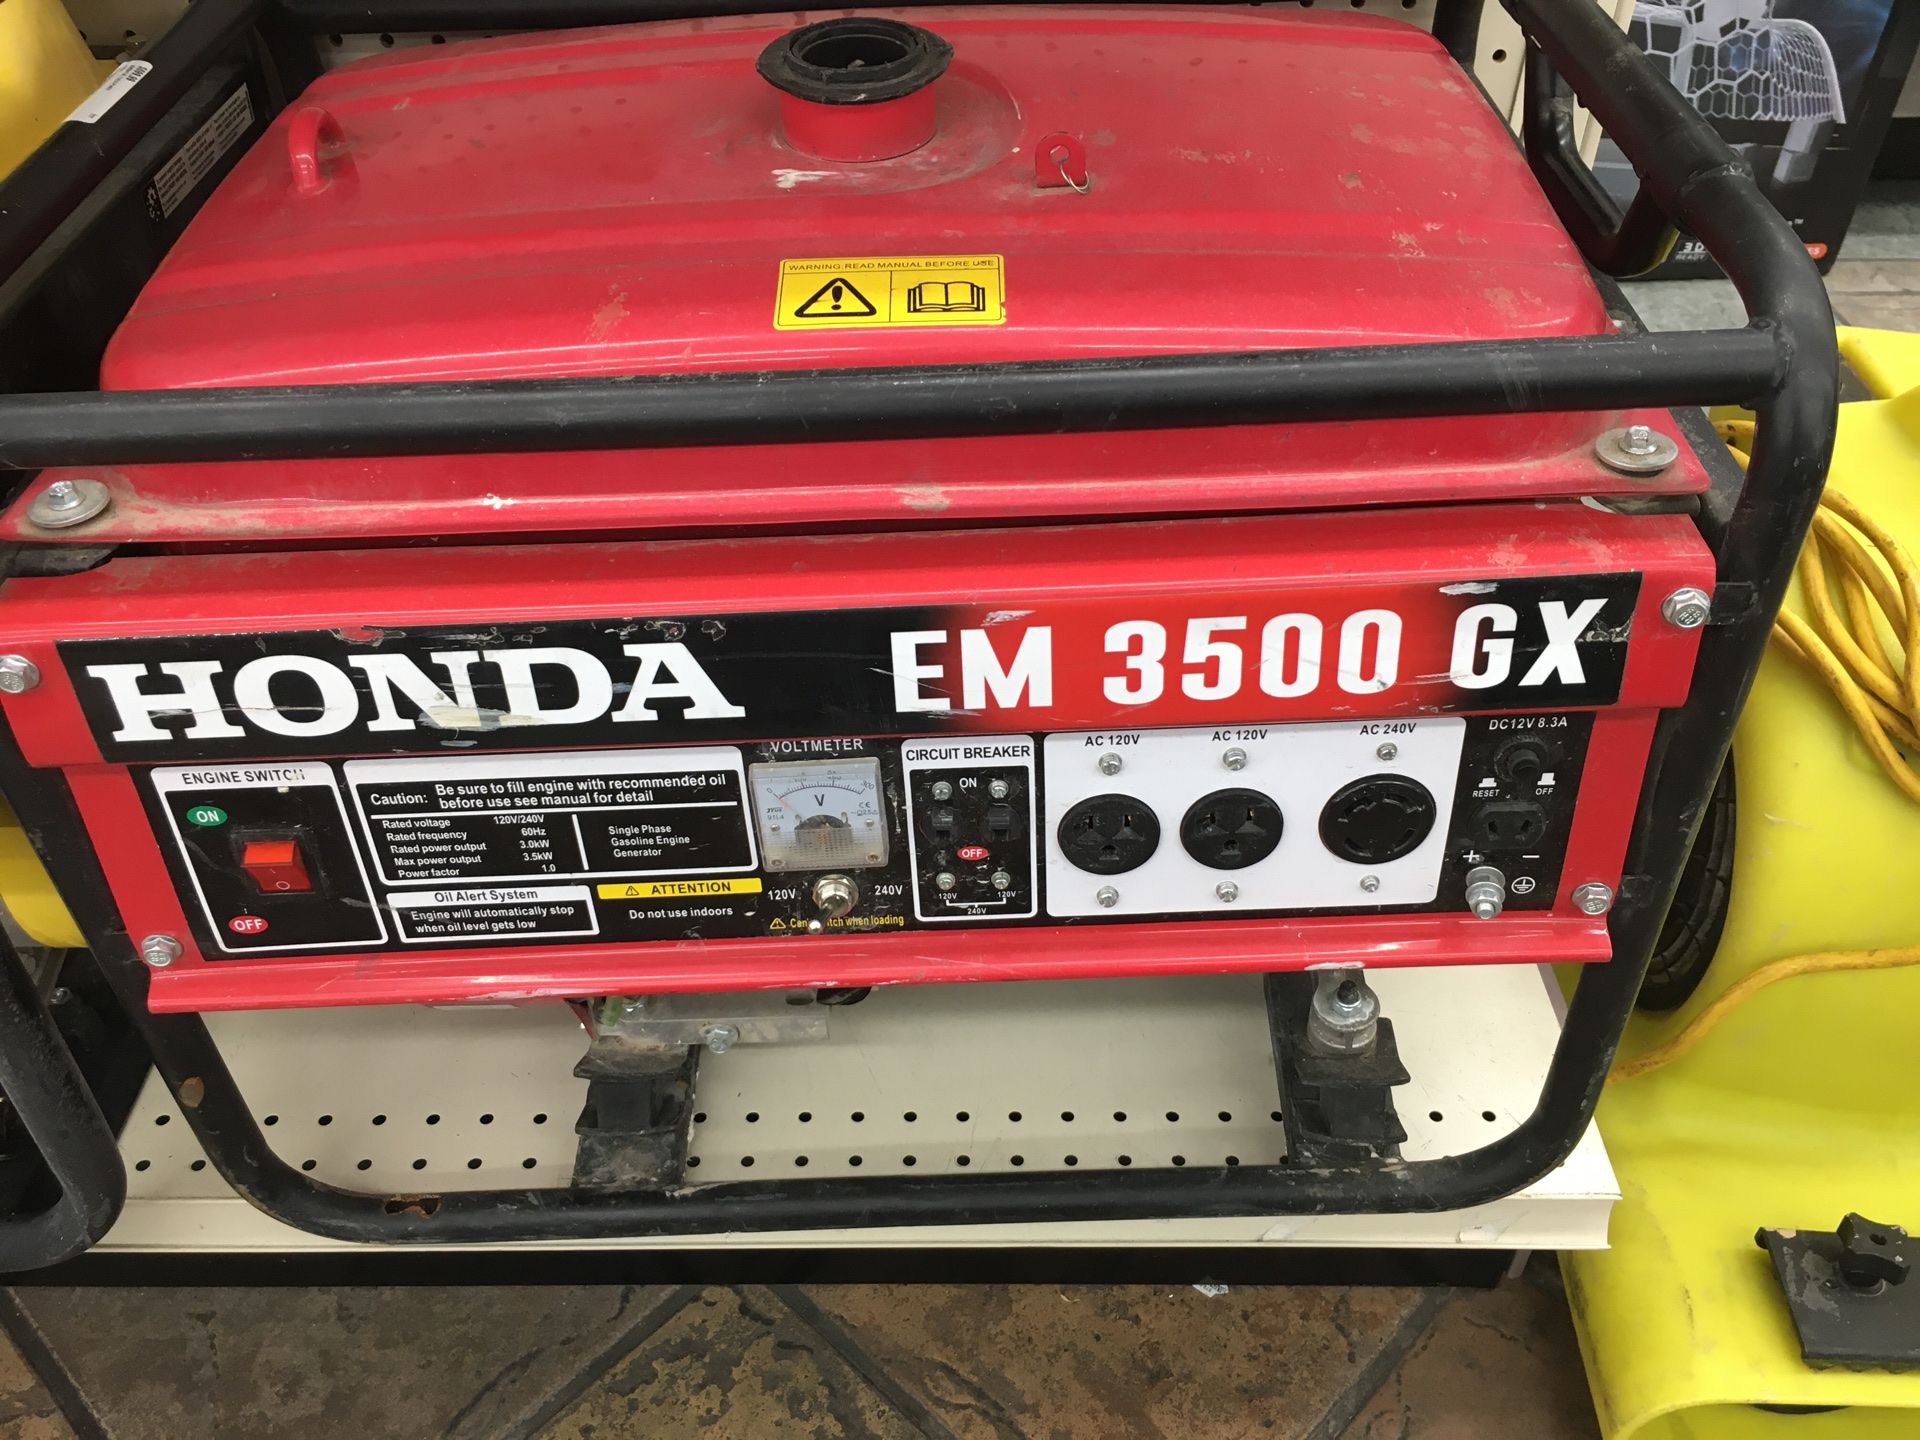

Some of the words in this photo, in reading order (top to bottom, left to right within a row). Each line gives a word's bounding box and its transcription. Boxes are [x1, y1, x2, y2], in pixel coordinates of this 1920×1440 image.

[877, 261, 922, 269] MANUAL
[925, 260, 970, 268] BEFORE
[890, 626, 1053, 713] EM
[1103, 609, 1402, 704] 3500
[1449, 598, 1609, 691] GX
[86, 642, 746, 742] HONDA
[1538, 716, 1567, 728] 8.3A
[1212, 730, 1231, 742] AC
[1236, 729, 1268, 741] 120V
[1360, 724, 1380, 736] AC
[1382, 723, 1417, 735] 240V
[770, 739, 863, 752] VOLTMETER
[1085, 736, 1104, 746] AC
[1108, 734, 1140, 746] 120V
[906, 747, 960, 761] CIRCUIT
[963, 745, 1030, 759] BREAKER
[181, 771, 242, 785] ENGINE
[435, 784, 454, 796] Be
[457, 785, 488, 795] sure
[490, 782, 505, 794] to
[507, 781, 525, 793] fill
[527, 780, 574, 795] engine
[577, 778, 606, 791] with
[608, 775, 706, 790] recommended
[709, 773, 726, 786] oil
[959, 778, 977, 788] ON
[1472, 790, 1500, 798] RESET
[1535, 788, 1554, 796] OFF
[370, 793, 428, 806] Caution:
[439, 797, 484, 809] before
[487, 798, 511, 808] use
[514, 796, 538, 807] see
[541, 792, 591, 805] manual
[593, 792, 613, 804] for
[615, 790, 654, 803] detail
[814, 794, 825, 807] V
[196, 810, 219, 823] ON
[382, 818, 412, 829] Rated
[414, 818, 451, 829] voltage
[493, 814, 545, 825] 120V/240V
[386, 831, 416, 842] Rated
[417, 831, 467, 843] frequency
[521, 827, 546, 836] 60Hz
[608, 825, 640, 837] Single
[641, 824, 672, 834] Phase
[390, 844, 420, 854] Rated
[421, 844, 452, 855] power
[454, 842, 487, 852] output
[519, 840, 550, 849] 3.0kW
[610, 836, 654, 847] Gasoline
[656, 836, 690, 846] Engine
[394, 857, 416, 867] Max
[417, 857, 447, 867] power
[449, 855, 482, 865] output
[522, 852, 553, 861] 3.5kW
[613, 848, 662, 858] Generator
[962, 848, 983, 858] OFF
[398, 869, 429, 879] Power
[431, 867, 460, 877] factor
[541, 864, 556, 873] 1.0
[651, 882, 731, 895] ATTENTION
[768, 888, 796, 900] 120V
[875, 885, 903, 896] 240V
[997, 890, 1016, 898] 120V
[434, 891, 452, 903] Oil
[456, 890, 487, 902] Alert
[489, 889, 538, 902] System
[938, 892, 957, 900] 120V
[411, 910, 450, 922] Engine
[452, 907, 471, 919] will
[474, 906, 547, 919] automatically
[550, 905, 574, 917] stop
[629, 909, 645, 920] Do
[648, 908, 666, 918] not
[668, 909, 687, 918] use
[690, 906, 733, 917] indoors
[234, 919, 263, 930] OFF
[415, 923, 446, 933] when
[448, 921, 461, 932] oil
[463, 920, 490, 931] level
[492, 920, 515, 931] gets
[517, 919, 537, 929] low
[845, 916, 870, 926] when
[870, 914, 904, 927] loading
